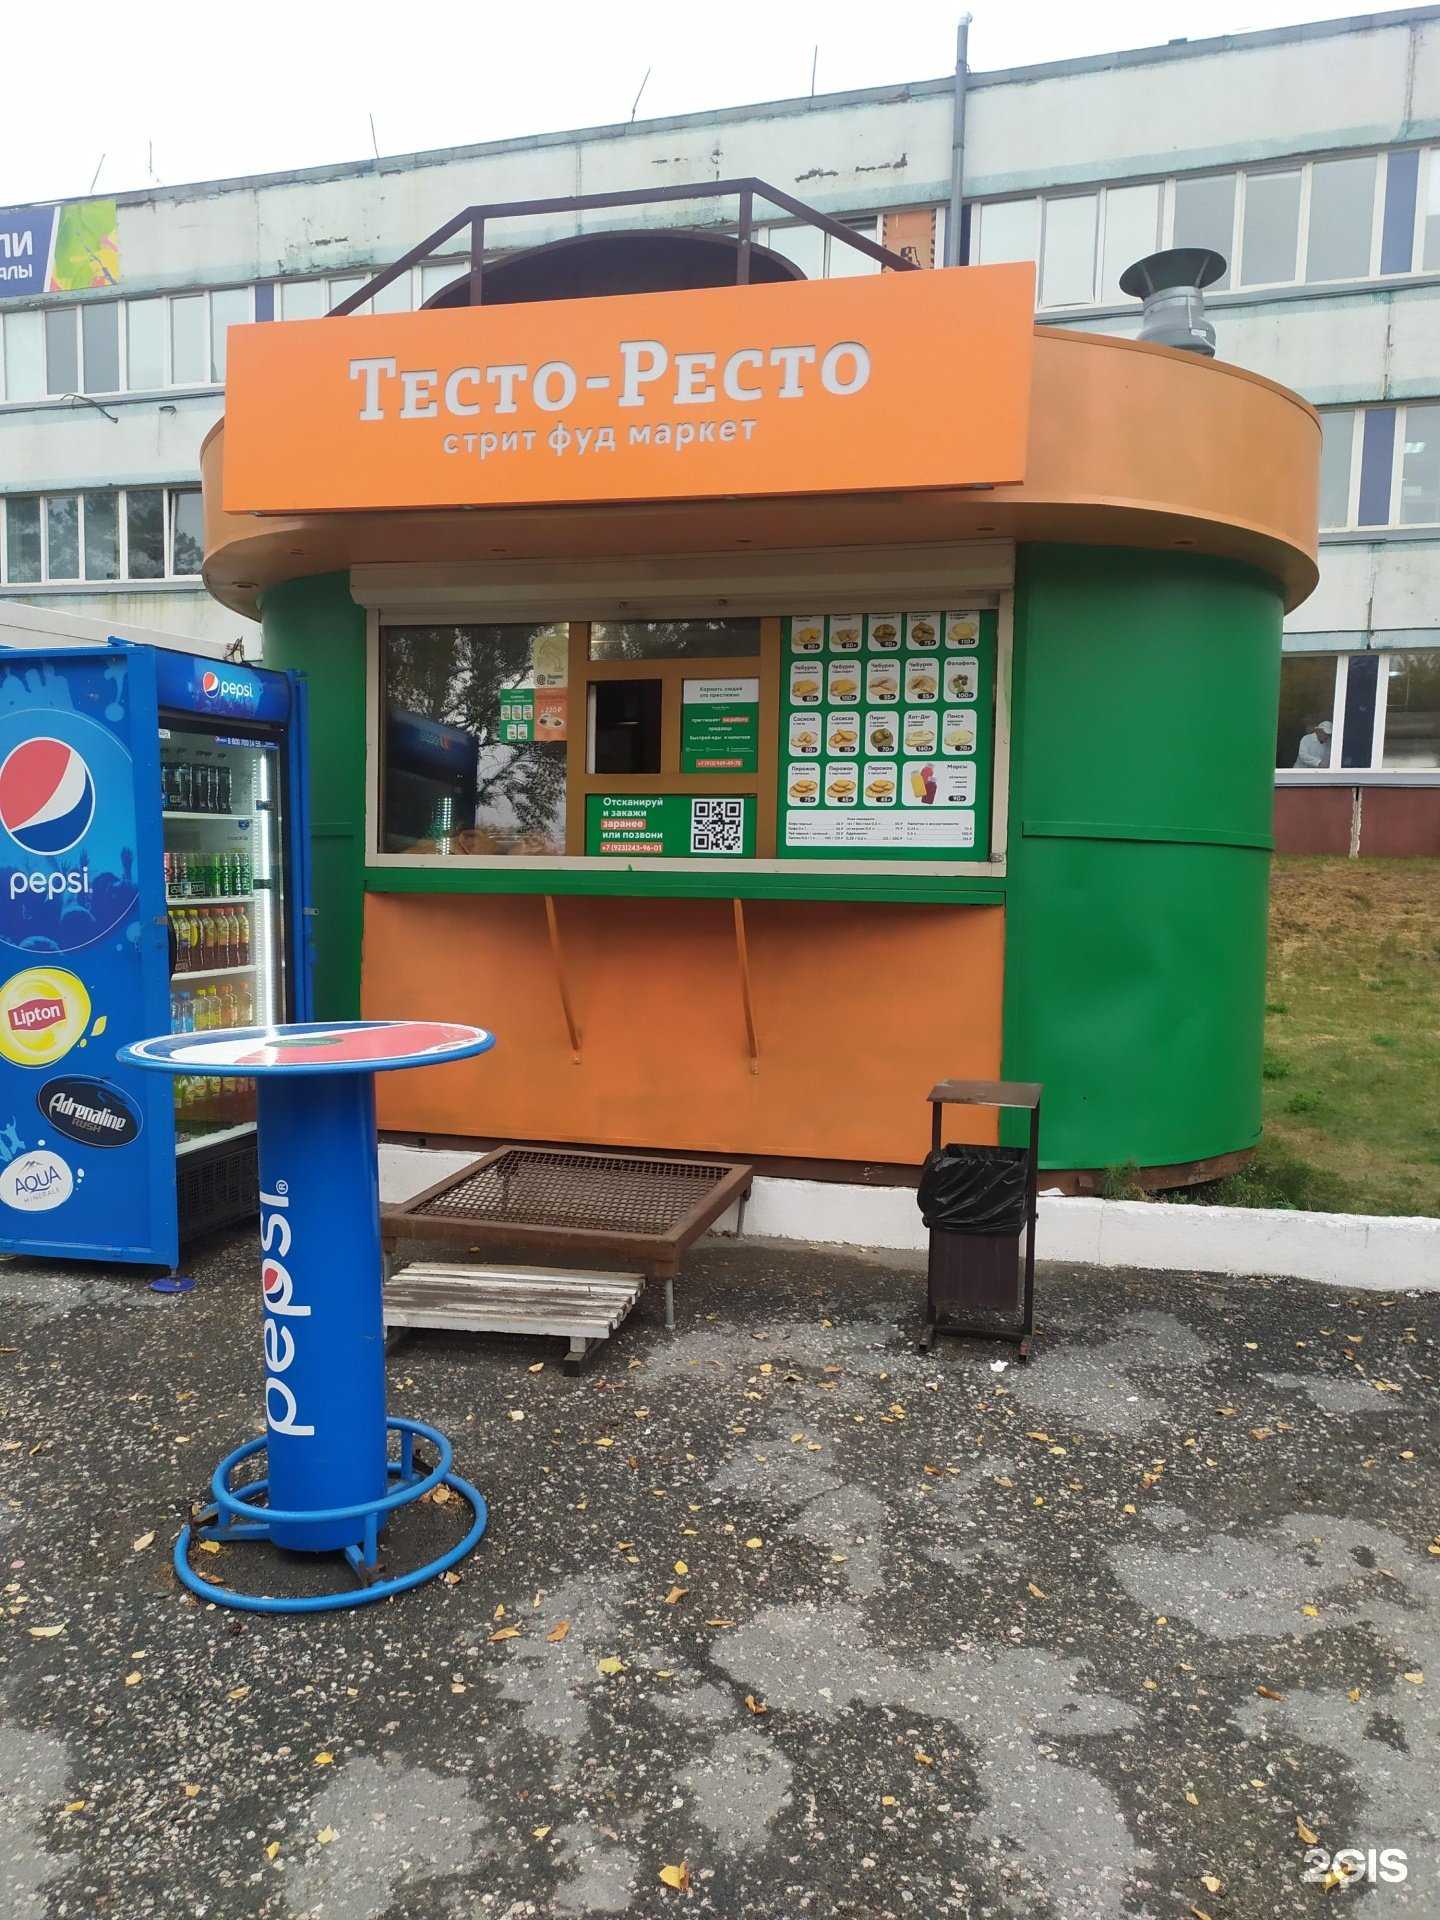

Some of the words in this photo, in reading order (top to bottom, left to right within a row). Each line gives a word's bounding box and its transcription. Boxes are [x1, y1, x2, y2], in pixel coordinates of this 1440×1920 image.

[442, 429, 537, 459] стрит
[548, 421, 616, 456] фуд
[629, 418, 758, 450] маркет
[220, 681, 253, 699] pepsi
[603, 797, 664, 808] Отсканируй
[603, 820, 643, 829] заранее
[10, 866, 89, 900] pepsi
[13, 1003, 61, 1027] Lipton
[49, 1092, 127, 1132] Adrenaline
[15, 1165, 62, 1195] AQUA
[259, 1191, 315, 1436] pepsi
